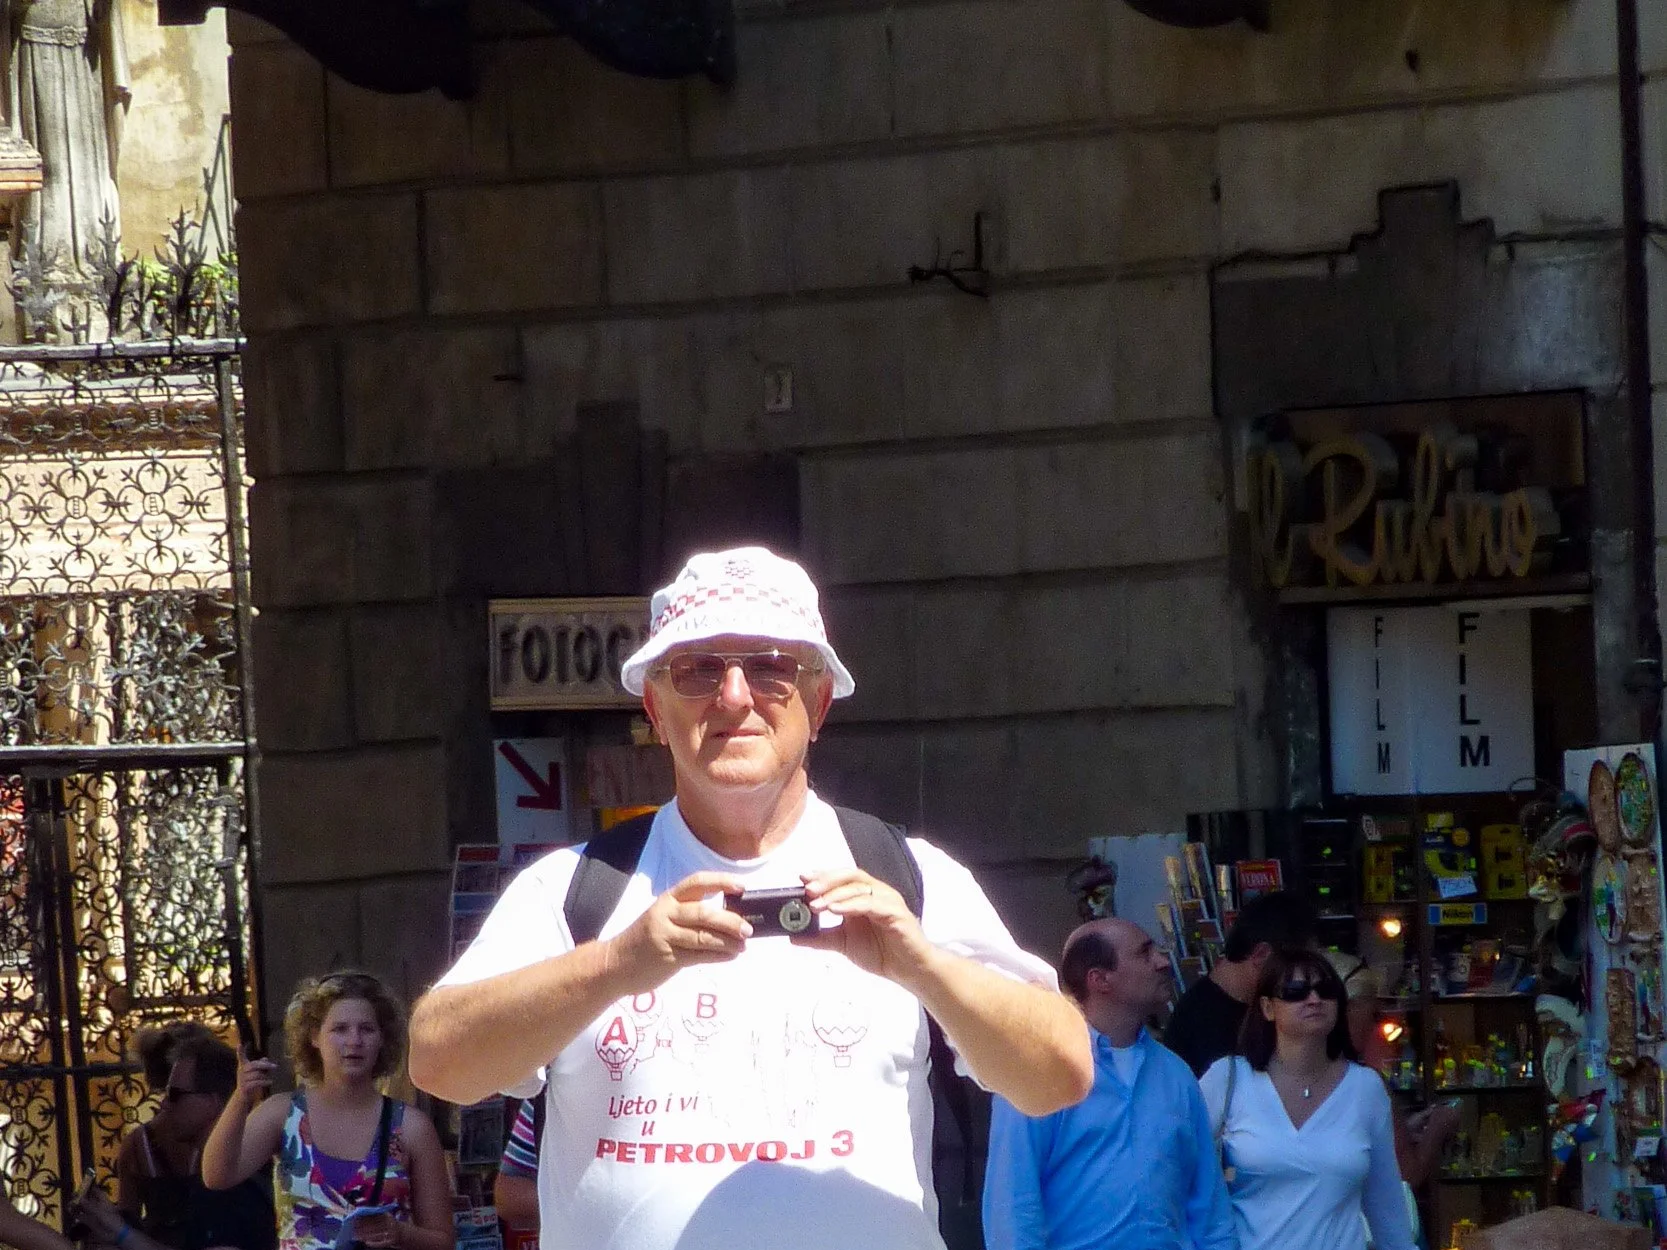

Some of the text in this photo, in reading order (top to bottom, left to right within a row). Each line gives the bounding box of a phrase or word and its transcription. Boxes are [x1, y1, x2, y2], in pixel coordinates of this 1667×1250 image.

[1374, 616, 1391, 774] FILM
[1457, 611, 1491, 768] FILM
[696, 993, 718, 1019] B
[602, 1016, 629, 1046] A
[608, 1095, 658, 1119] Ljeto
[665, 1092, 673, 1113] i
[641, 1120, 655, 1137] u
[596, 1129, 855, 1164] PETROVOJ 3
